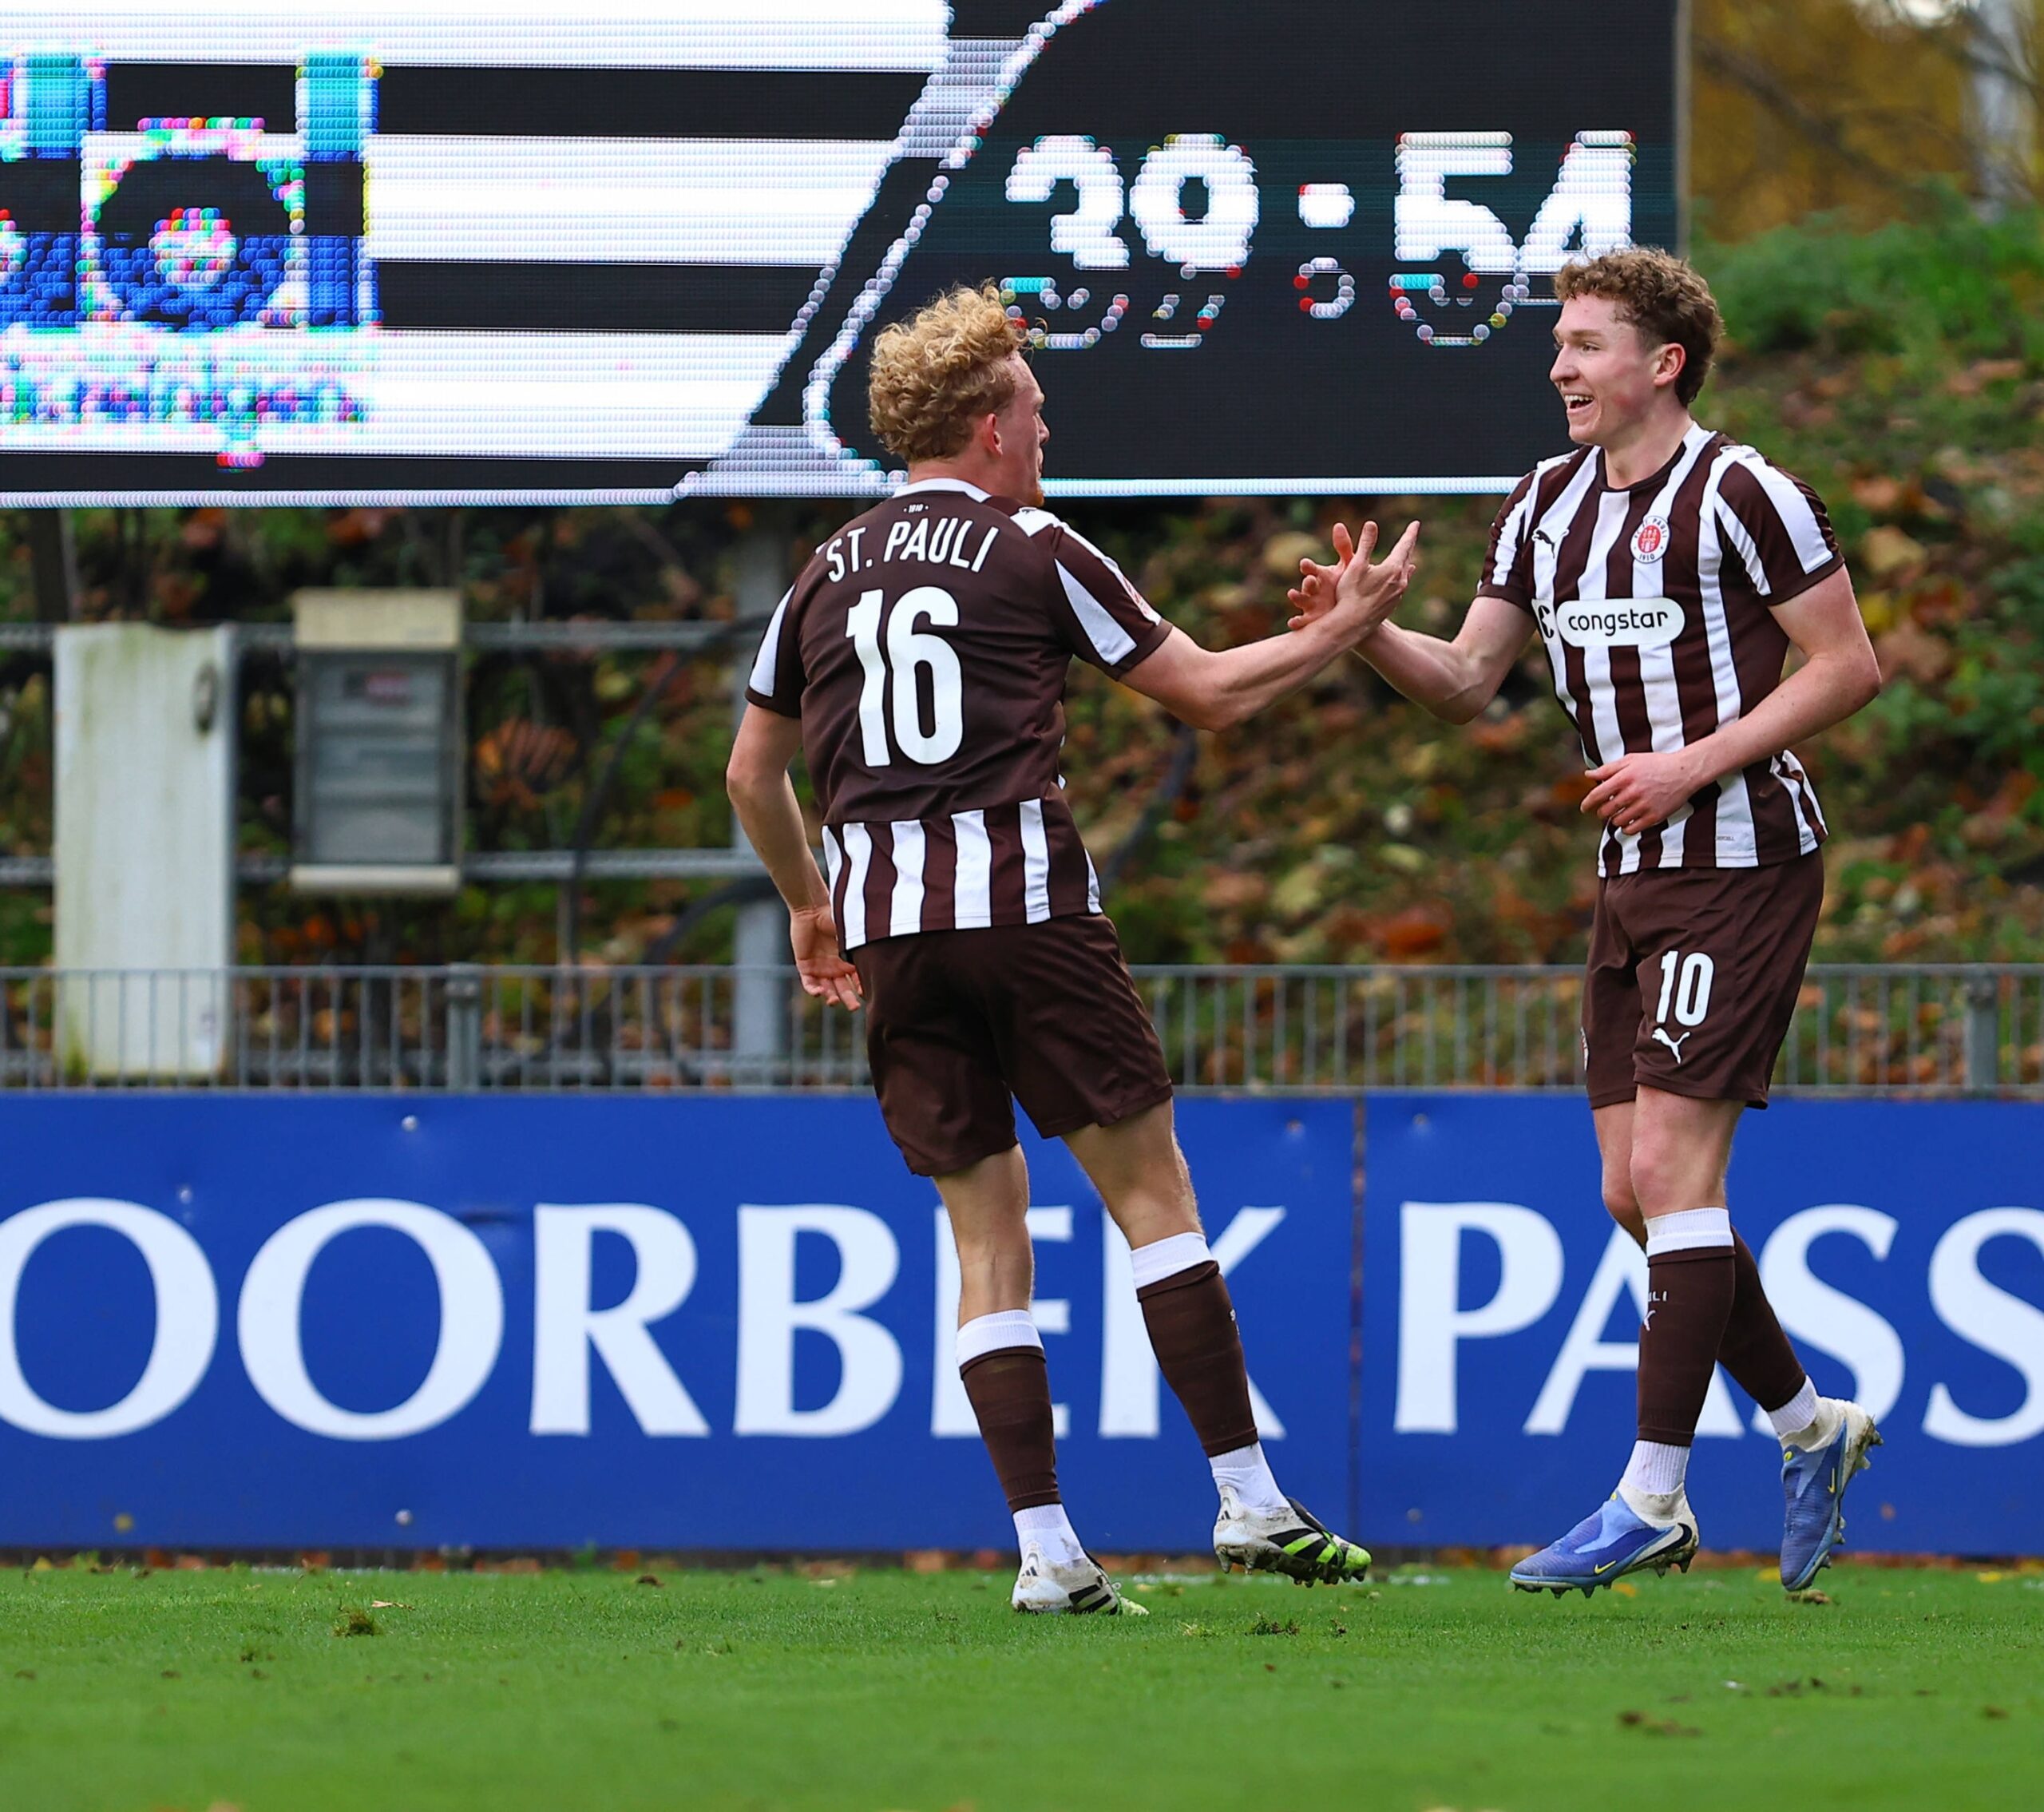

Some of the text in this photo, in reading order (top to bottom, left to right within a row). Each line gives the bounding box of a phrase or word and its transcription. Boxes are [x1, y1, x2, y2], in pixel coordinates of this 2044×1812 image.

[826, 517, 1000, 583] ST. PAULI
[1567, 609, 1669, 636] congstar
[844, 585, 964, 767] 16
[1655, 950, 1715, 1027] 10
